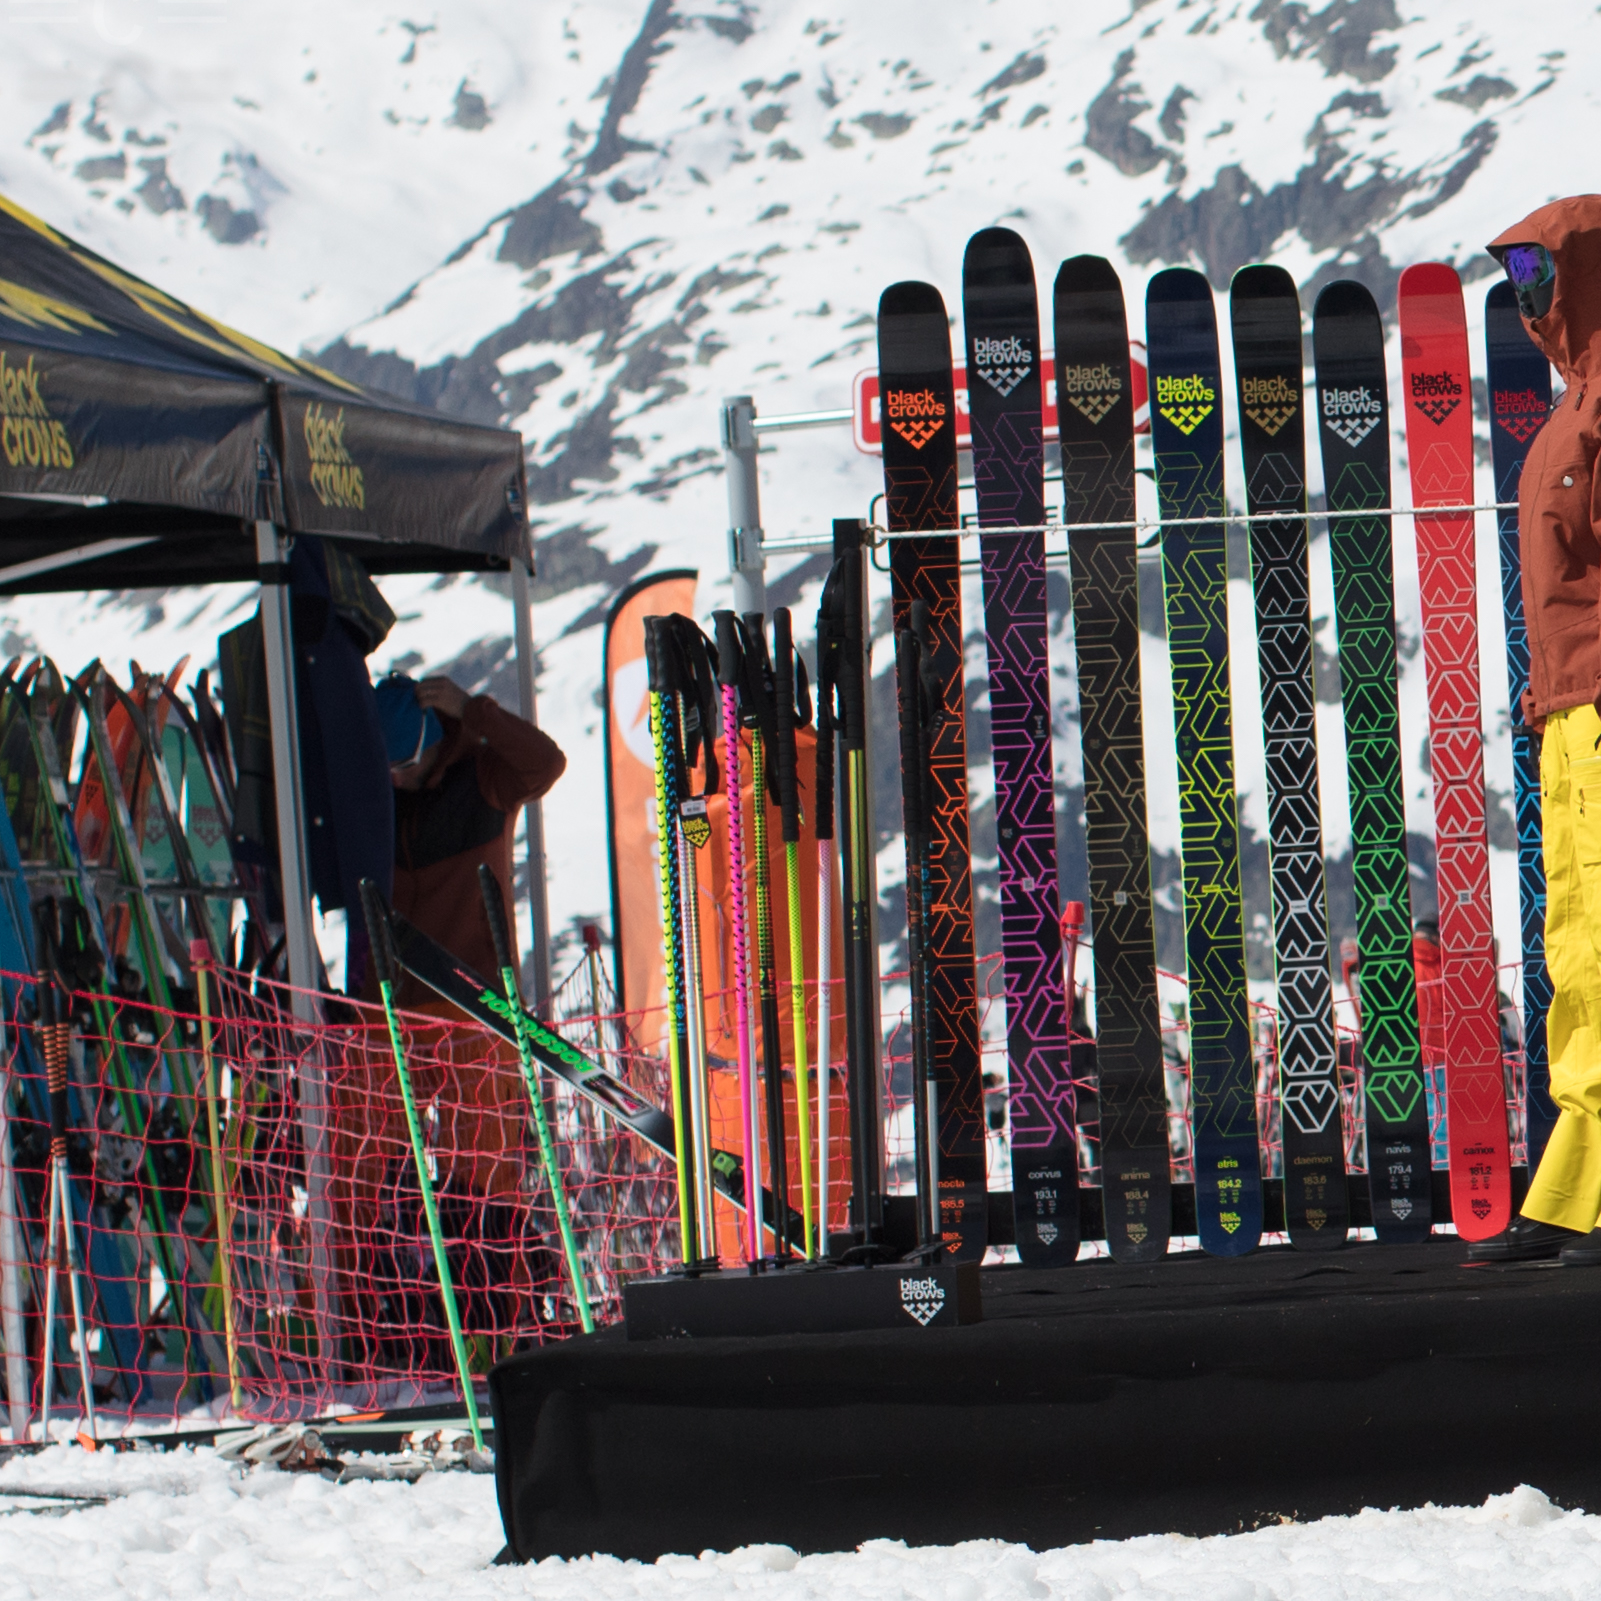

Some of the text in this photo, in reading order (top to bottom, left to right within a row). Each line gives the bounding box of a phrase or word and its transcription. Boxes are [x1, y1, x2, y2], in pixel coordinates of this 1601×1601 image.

[974, 336, 1022, 353] black
[975, 349, 1031, 365] crows
[1066, 364, 1113, 381] black
[1411, 371, 1453, 388] black
[0, 350, 50, 419] lack
[1067, 378, 1122, 393] crows
[1157, 374, 1204, 392] black
[1242, 375, 1287, 393] black
[888, 389, 935, 406] black
[1158, 388, 1215, 404] crows
[1243, 388, 1299, 404] crows
[1321, 386, 1370, 403] black
[1411, 385, 1463, 398] crows
[1494, 389, 1537, 405] black
[890, 402, 946, 418] crows
[1323, 400, 1381, 416] crows
[1495, 401, 1547, 416] crows
[2, 416, 74, 470] crows
[1386, 1144, 1412, 1154] navis
[1217, 1159, 1239, 1169] atris
[1293, 1155, 1333, 1165] daemon
[1028, 1170, 1061, 1180] corvus
[1388, 1165, 1413, 1175] 179.4
[937, 1178, 965, 1189] nocta
[1217, 1179, 1242, 1189] 184.2
[1034, 1190, 1057, 1199] 193.1
[900, 1276, 938, 1291] black
[901, 1287, 946, 1301] crows
